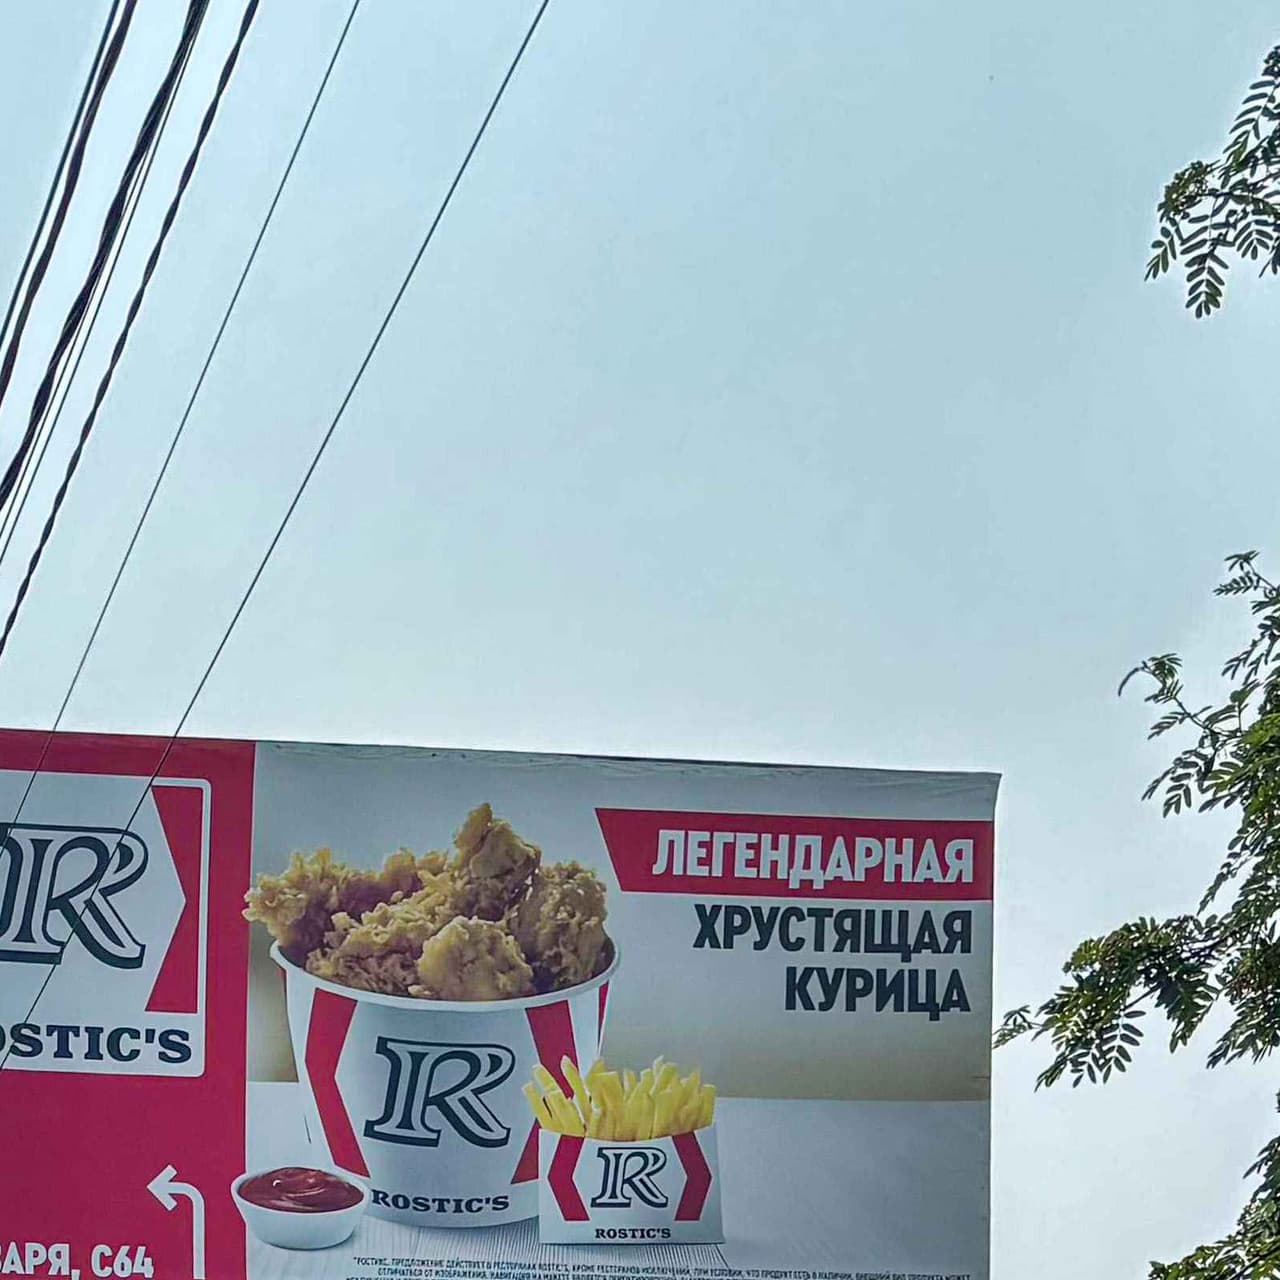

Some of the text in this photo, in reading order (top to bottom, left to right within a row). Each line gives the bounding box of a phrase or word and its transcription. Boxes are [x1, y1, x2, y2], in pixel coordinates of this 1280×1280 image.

[651, 829, 974, 889] ЛЕГЕНДАРНАЯ
[692, 904, 972, 962] ХРУСТЯЩАЯ
[784, 967, 972, 1020] КУРИЦА
[372, 1189, 510, 1214] ROSTIC'S
[595, 1227, 671, 1240] ROSTIC'S
